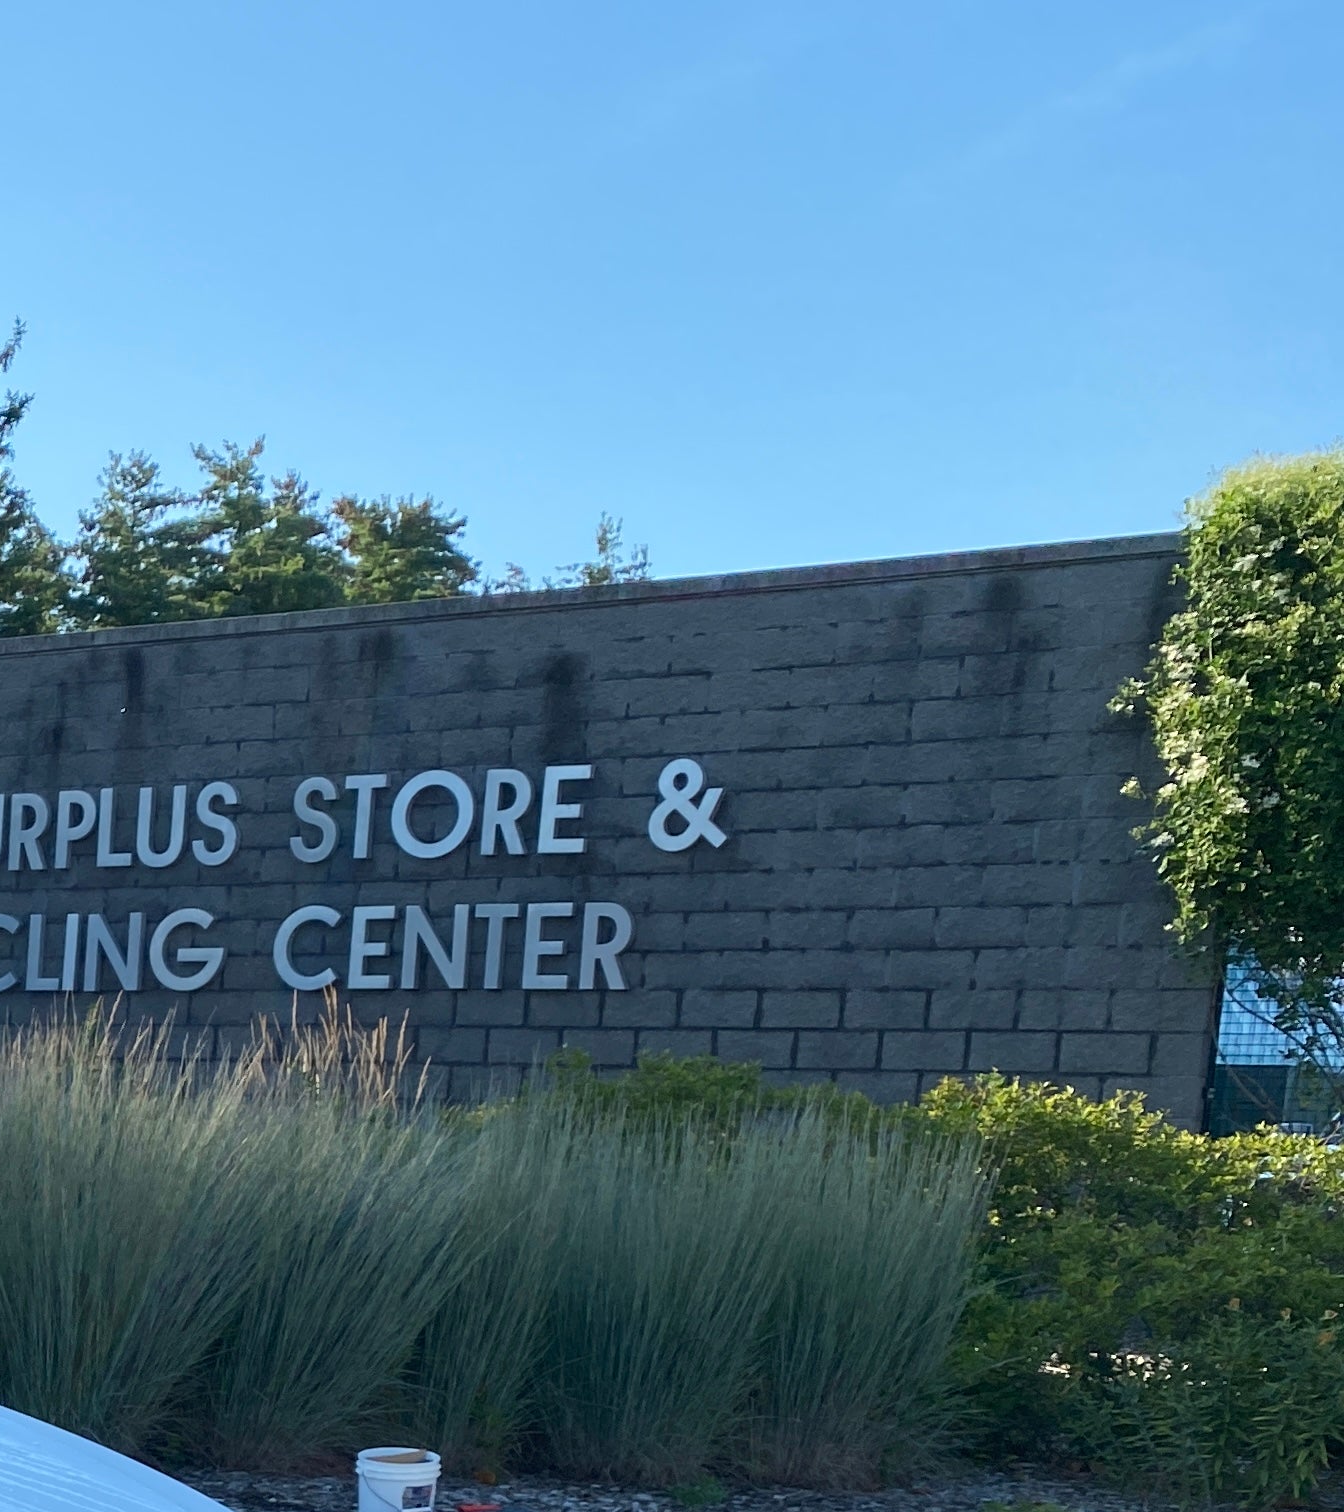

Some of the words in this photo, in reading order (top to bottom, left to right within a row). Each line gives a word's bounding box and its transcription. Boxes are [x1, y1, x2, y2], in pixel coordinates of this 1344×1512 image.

[289, 763, 596, 863] STORE
[648, 757, 727, 851] &
[272, 900, 636, 992] CENTER
